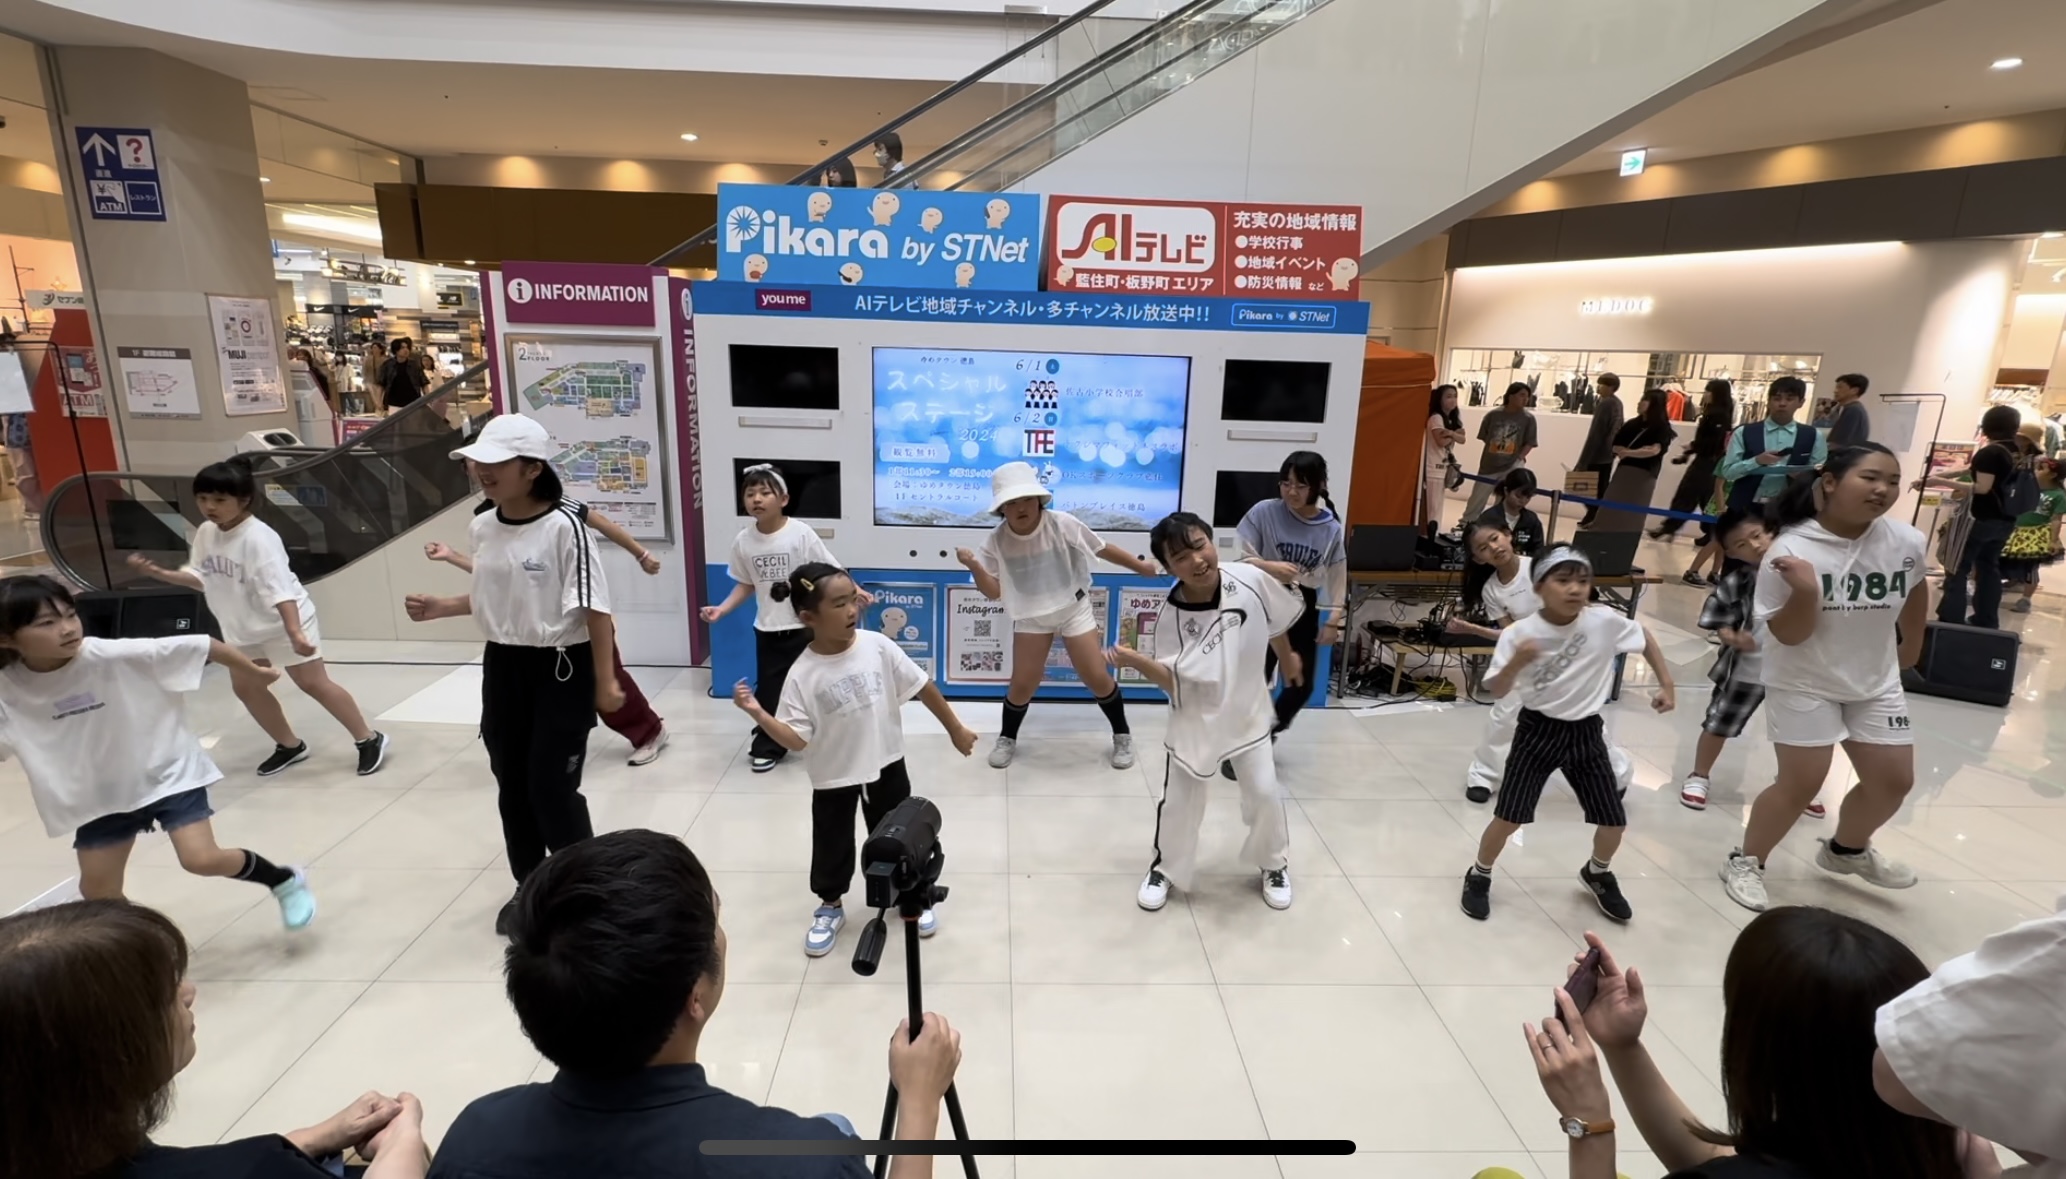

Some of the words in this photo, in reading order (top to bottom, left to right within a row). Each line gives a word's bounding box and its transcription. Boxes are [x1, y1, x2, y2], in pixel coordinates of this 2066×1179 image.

[99, 201, 123, 212] ATM
[1232, 210, 1357, 232] 充実の地域情報
[725, 205, 889, 259] Pikara
[901, 236, 934, 266] by
[941, 232, 1029, 264] STNet
[533, 282, 649, 304] INFORMATION
[1238, 308, 1273, 321] Pikara
[1298, 310, 1331, 323] STNet
[227, 349, 247, 360] MUJI
[518, 347, 528, 361] 2
[1015, 358, 1041, 372] 6/1
[887, 370, 1007, 394] スペシャル
[683, 329, 703, 510] INFORMATION
[900, 401, 994, 424] ステージ
[1013, 411, 1041, 425] 6/2
[957, 428, 998, 443] 2024
[754, 556, 787, 568] CECIL
[1821, 570, 1907, 602] 1984
[873, 589, 924, 605] Pikara
